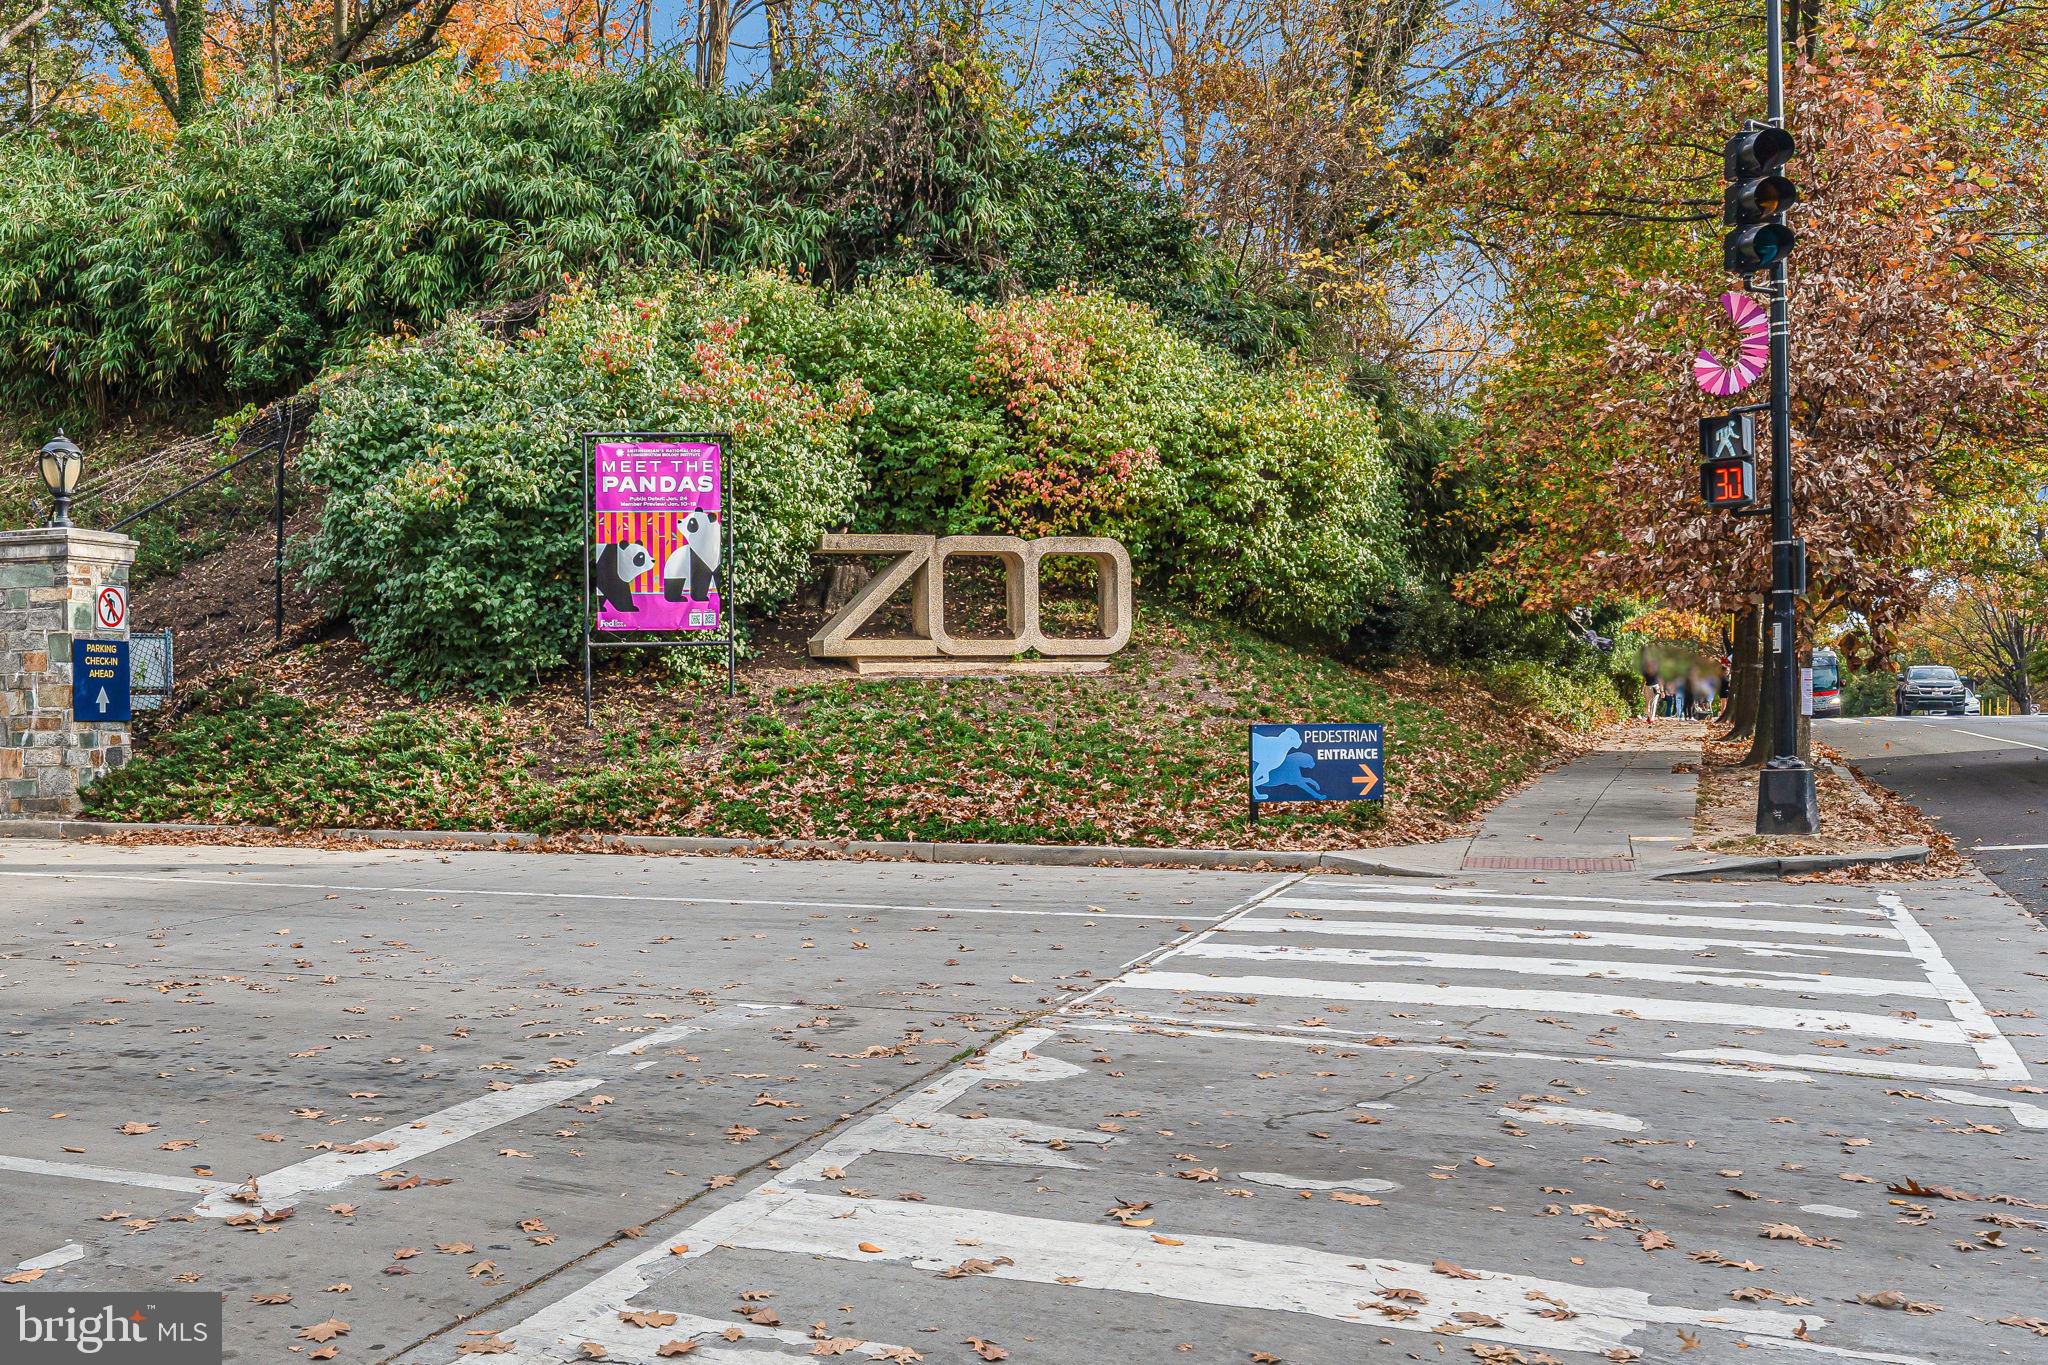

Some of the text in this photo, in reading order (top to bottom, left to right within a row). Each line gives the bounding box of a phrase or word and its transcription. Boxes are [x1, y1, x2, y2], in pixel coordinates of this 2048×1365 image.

[602, 460, 714, 473] MEET THE
[602, 476, 714, 493] PANDAS
[809, 534, 1132, 657] ZOO
[86, 644, 117, 653] PARKING
[85, 656, 118, 666] CHECK-IN
[88, 669, 115, 678] AHEAD
[1304, 729, 1378, 743] PEDESTRIAN
[1317, 748, 1378, 760] ENTRANCE
